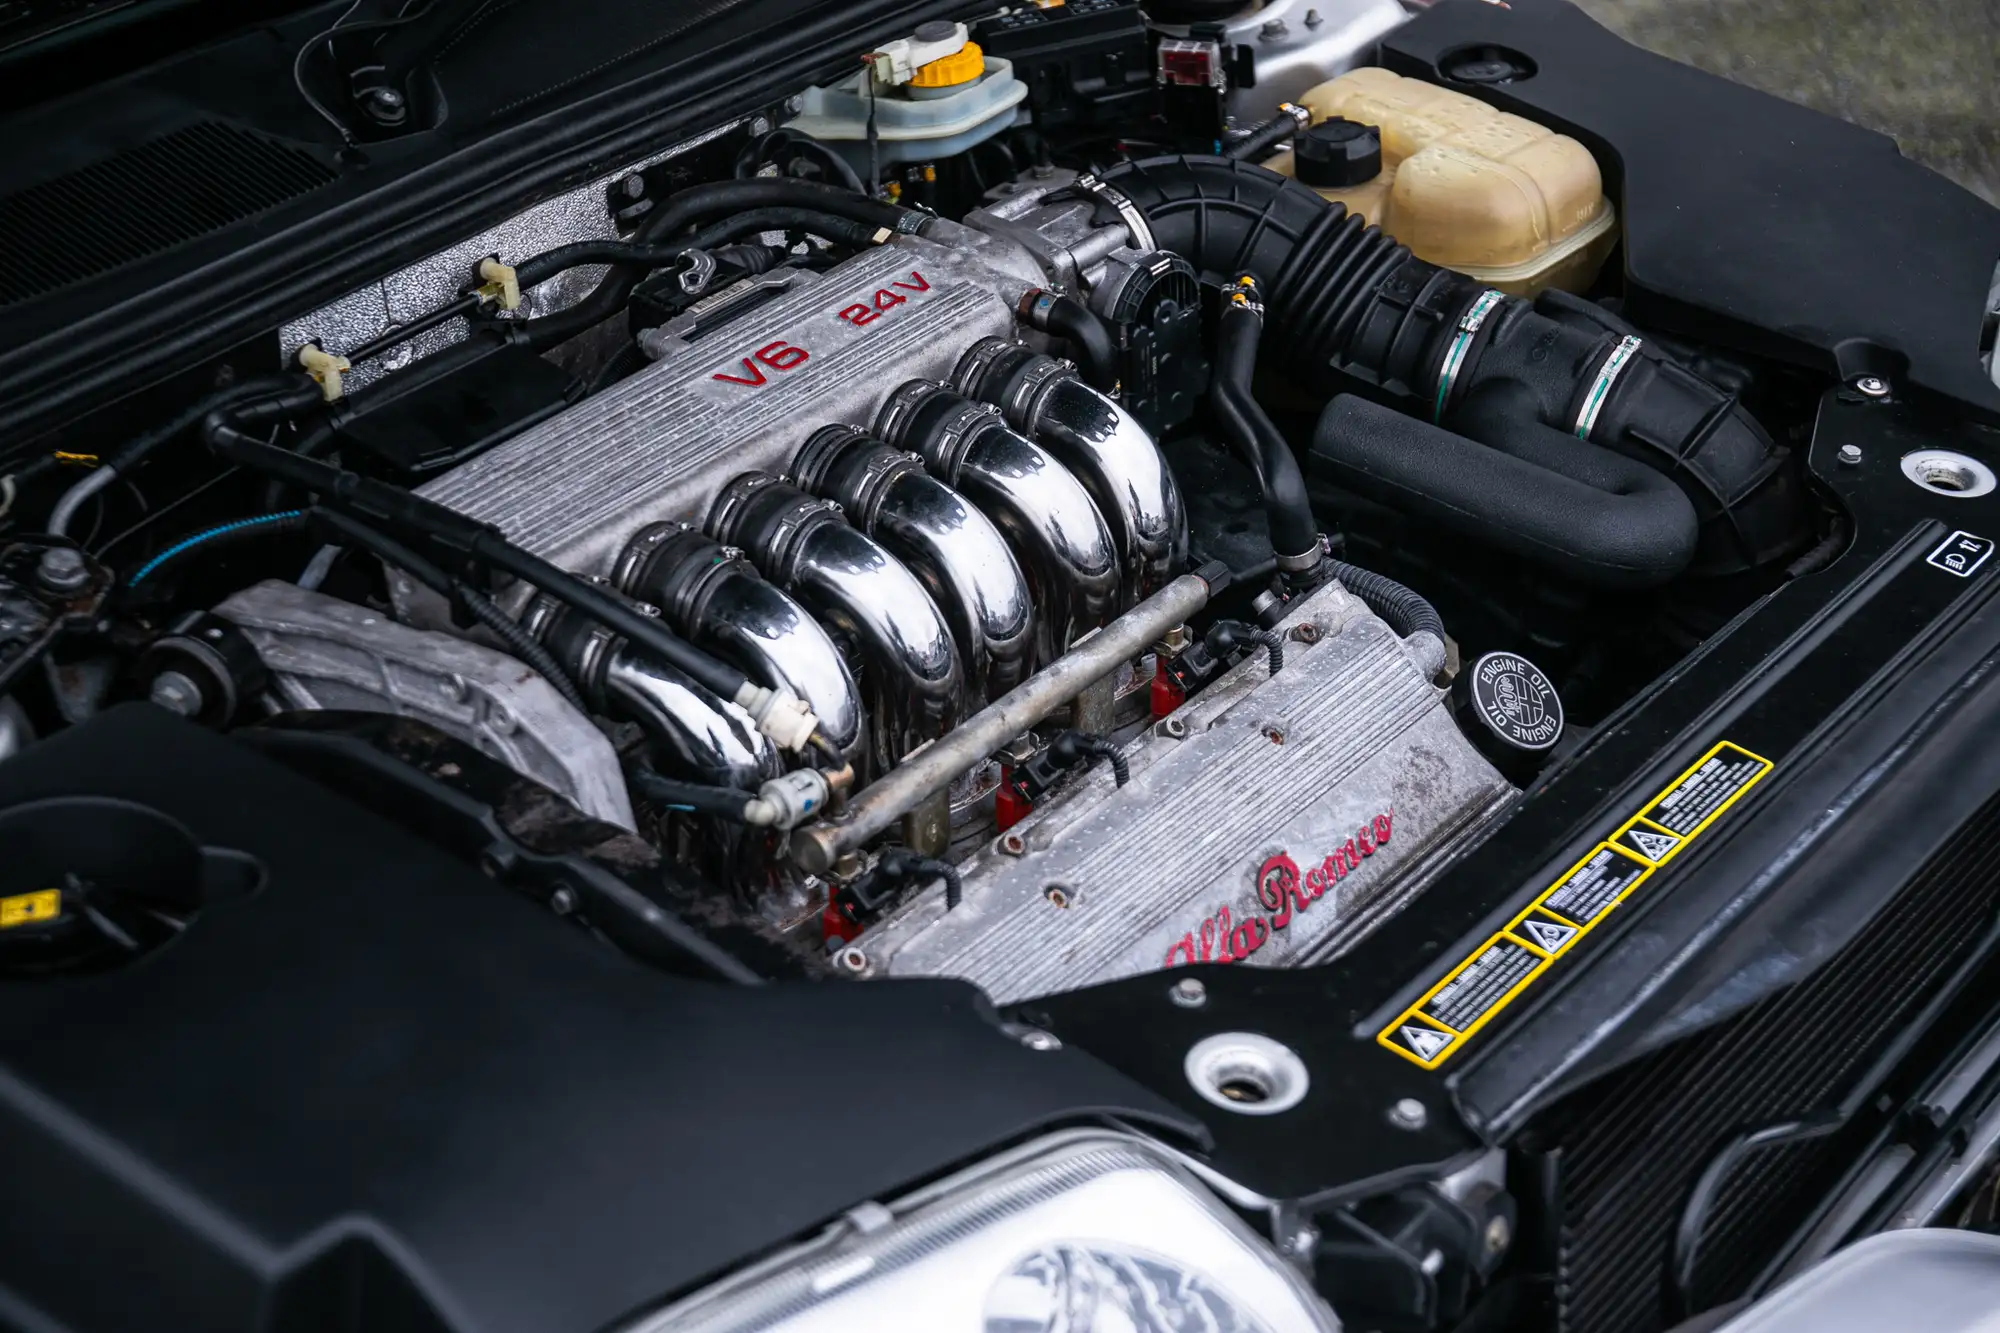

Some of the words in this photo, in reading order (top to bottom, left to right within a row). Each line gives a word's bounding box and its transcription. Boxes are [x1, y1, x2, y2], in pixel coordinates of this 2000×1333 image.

[712, 341, 809, 387] V6
[839, 271, 930, 326] 24V
[1481, 658, 1525, 684] ENGINE
[1530, 674, 1550, 699] OIL
[1487, 700, 1507, 727] OIL
[1513, 715, 1556, 742] ENGINE
[1257, 807, 1394, 929] Romeo
